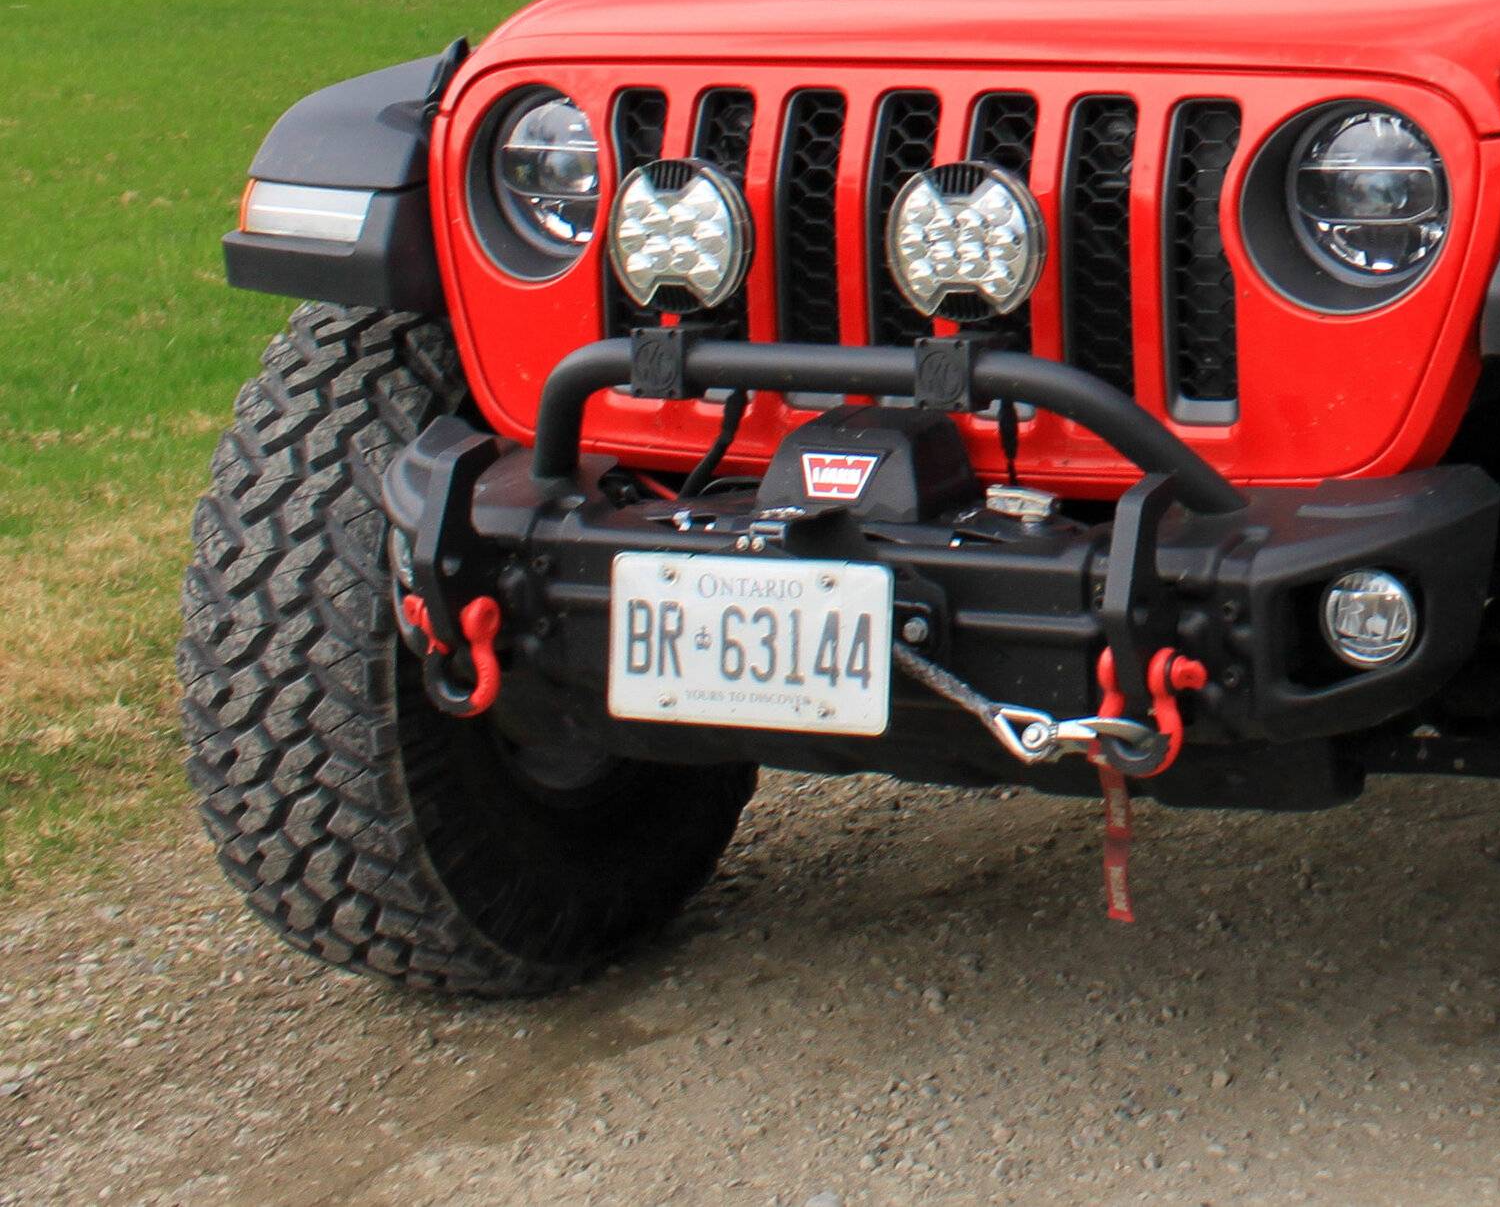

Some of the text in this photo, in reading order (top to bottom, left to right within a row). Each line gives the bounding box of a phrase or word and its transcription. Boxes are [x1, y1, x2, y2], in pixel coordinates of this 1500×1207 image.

[698, 573, 802, 598] ONTARIO
[626, 598, 874, 690] BR 63144
